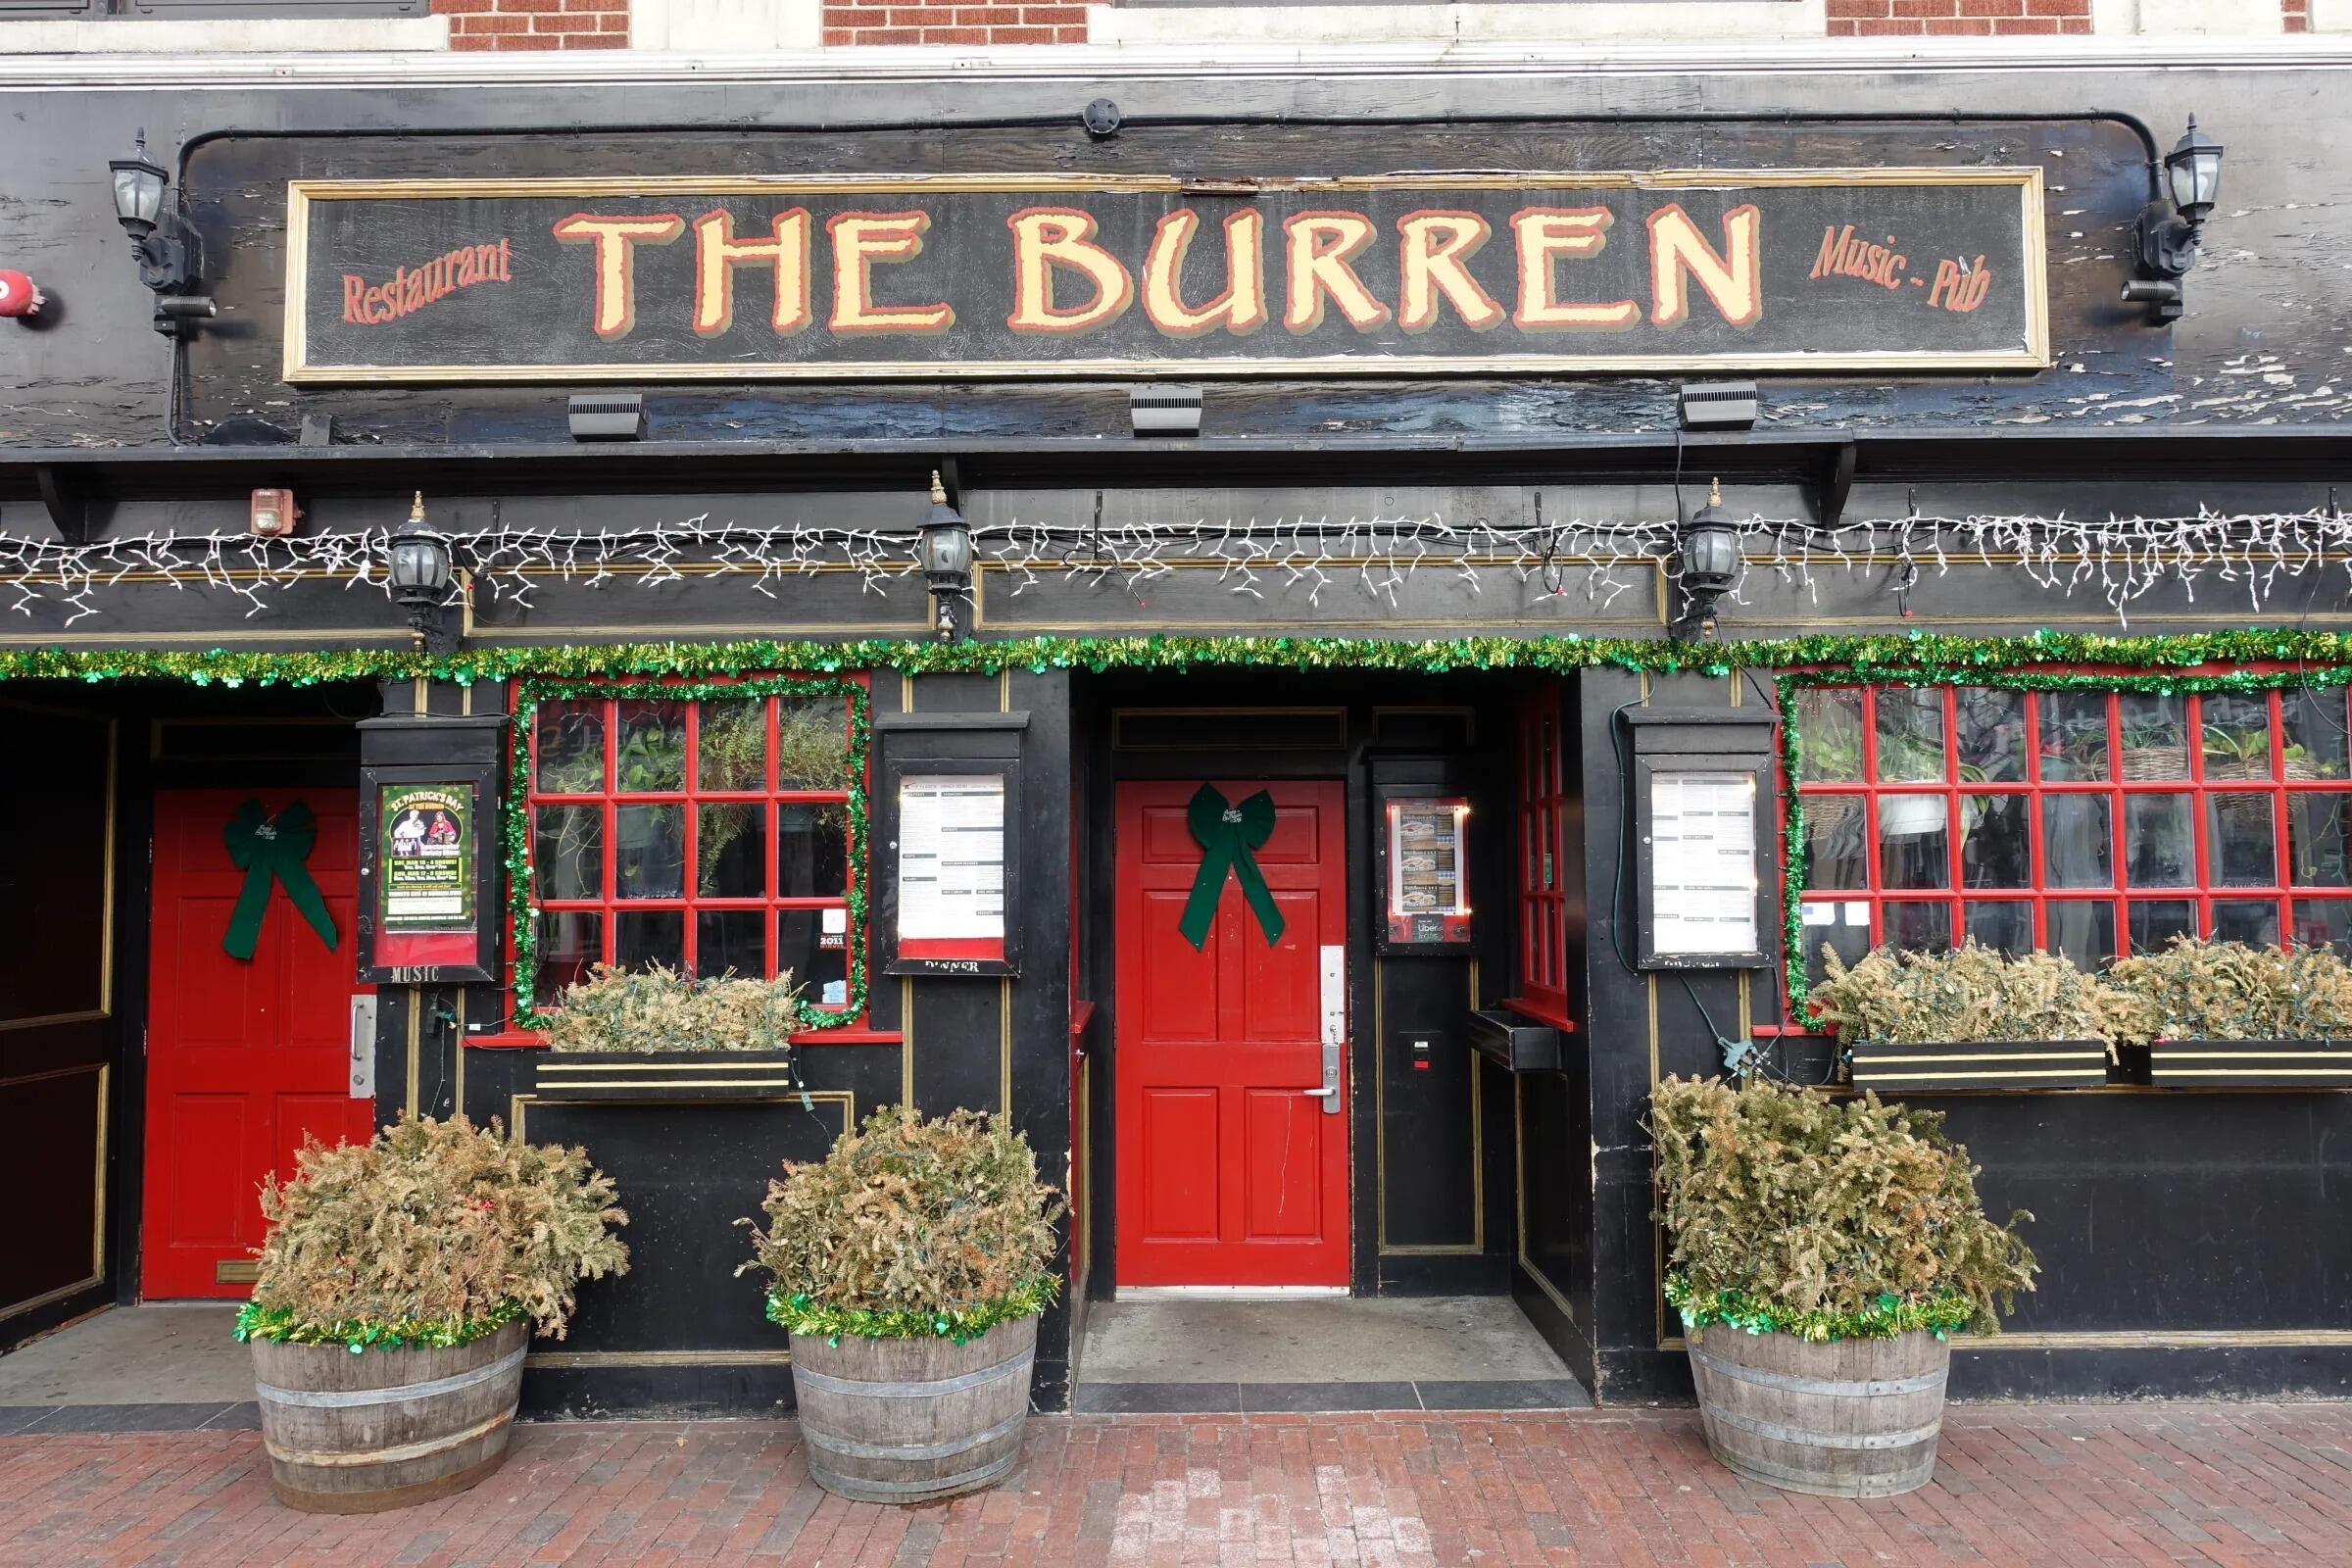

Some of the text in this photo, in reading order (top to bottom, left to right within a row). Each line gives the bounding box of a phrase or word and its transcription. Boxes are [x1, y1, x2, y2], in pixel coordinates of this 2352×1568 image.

[342, 237, 513, 325] Restaurant
[553, 203, 1764, 340] THE BURREN
[1809, 224, 1908, 290] Music
[1926, 255, 1991, 313] Pub
[403, 791, 447, 805] PATRICK'S
[445, 795, 465, 811] DAY
[391, 965, 439, 983] MUSIC
